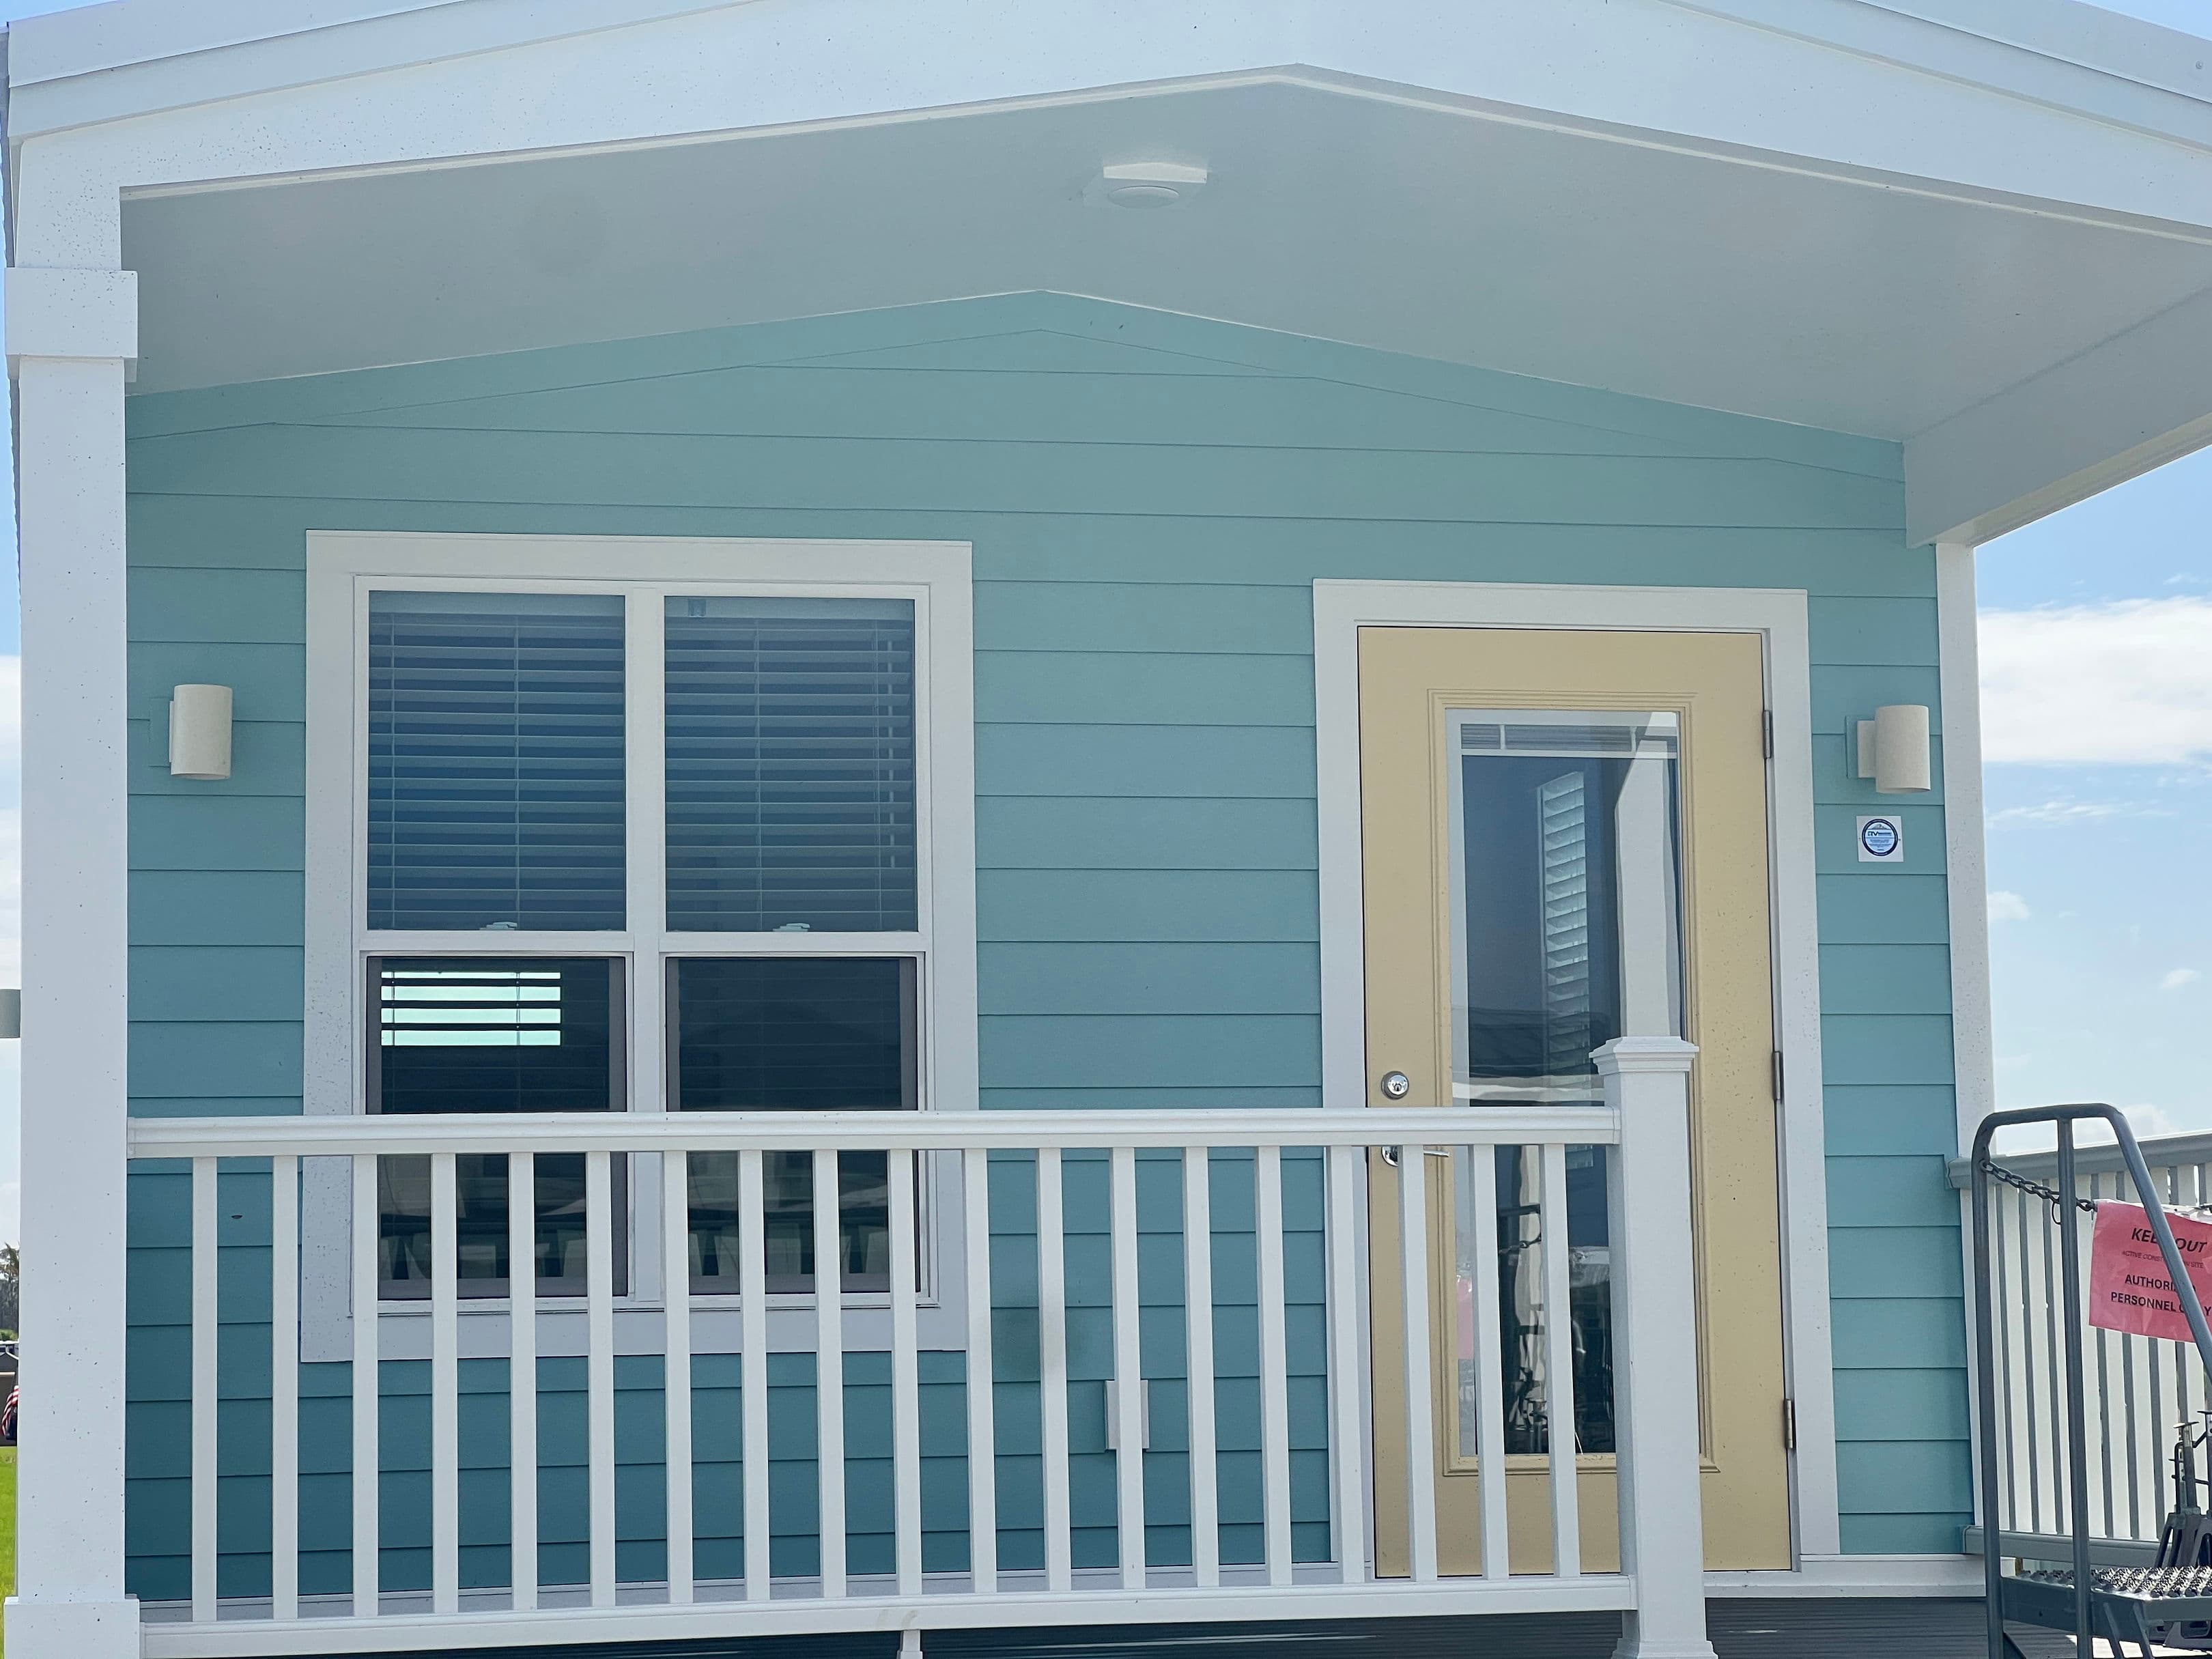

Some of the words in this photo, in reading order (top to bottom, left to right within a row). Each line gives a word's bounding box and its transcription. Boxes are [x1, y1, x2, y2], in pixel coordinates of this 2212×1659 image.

[2131, 1228, 2159, 1245] KEE
[2175, 1238, 2208, 1253] OUT
[2122, 1250, 2142, 1259] ACTIVE
[2125, 1274, 2196, 1292] AUTHORI
[2111, 1292, 2176, 1312] PERSONNEL
